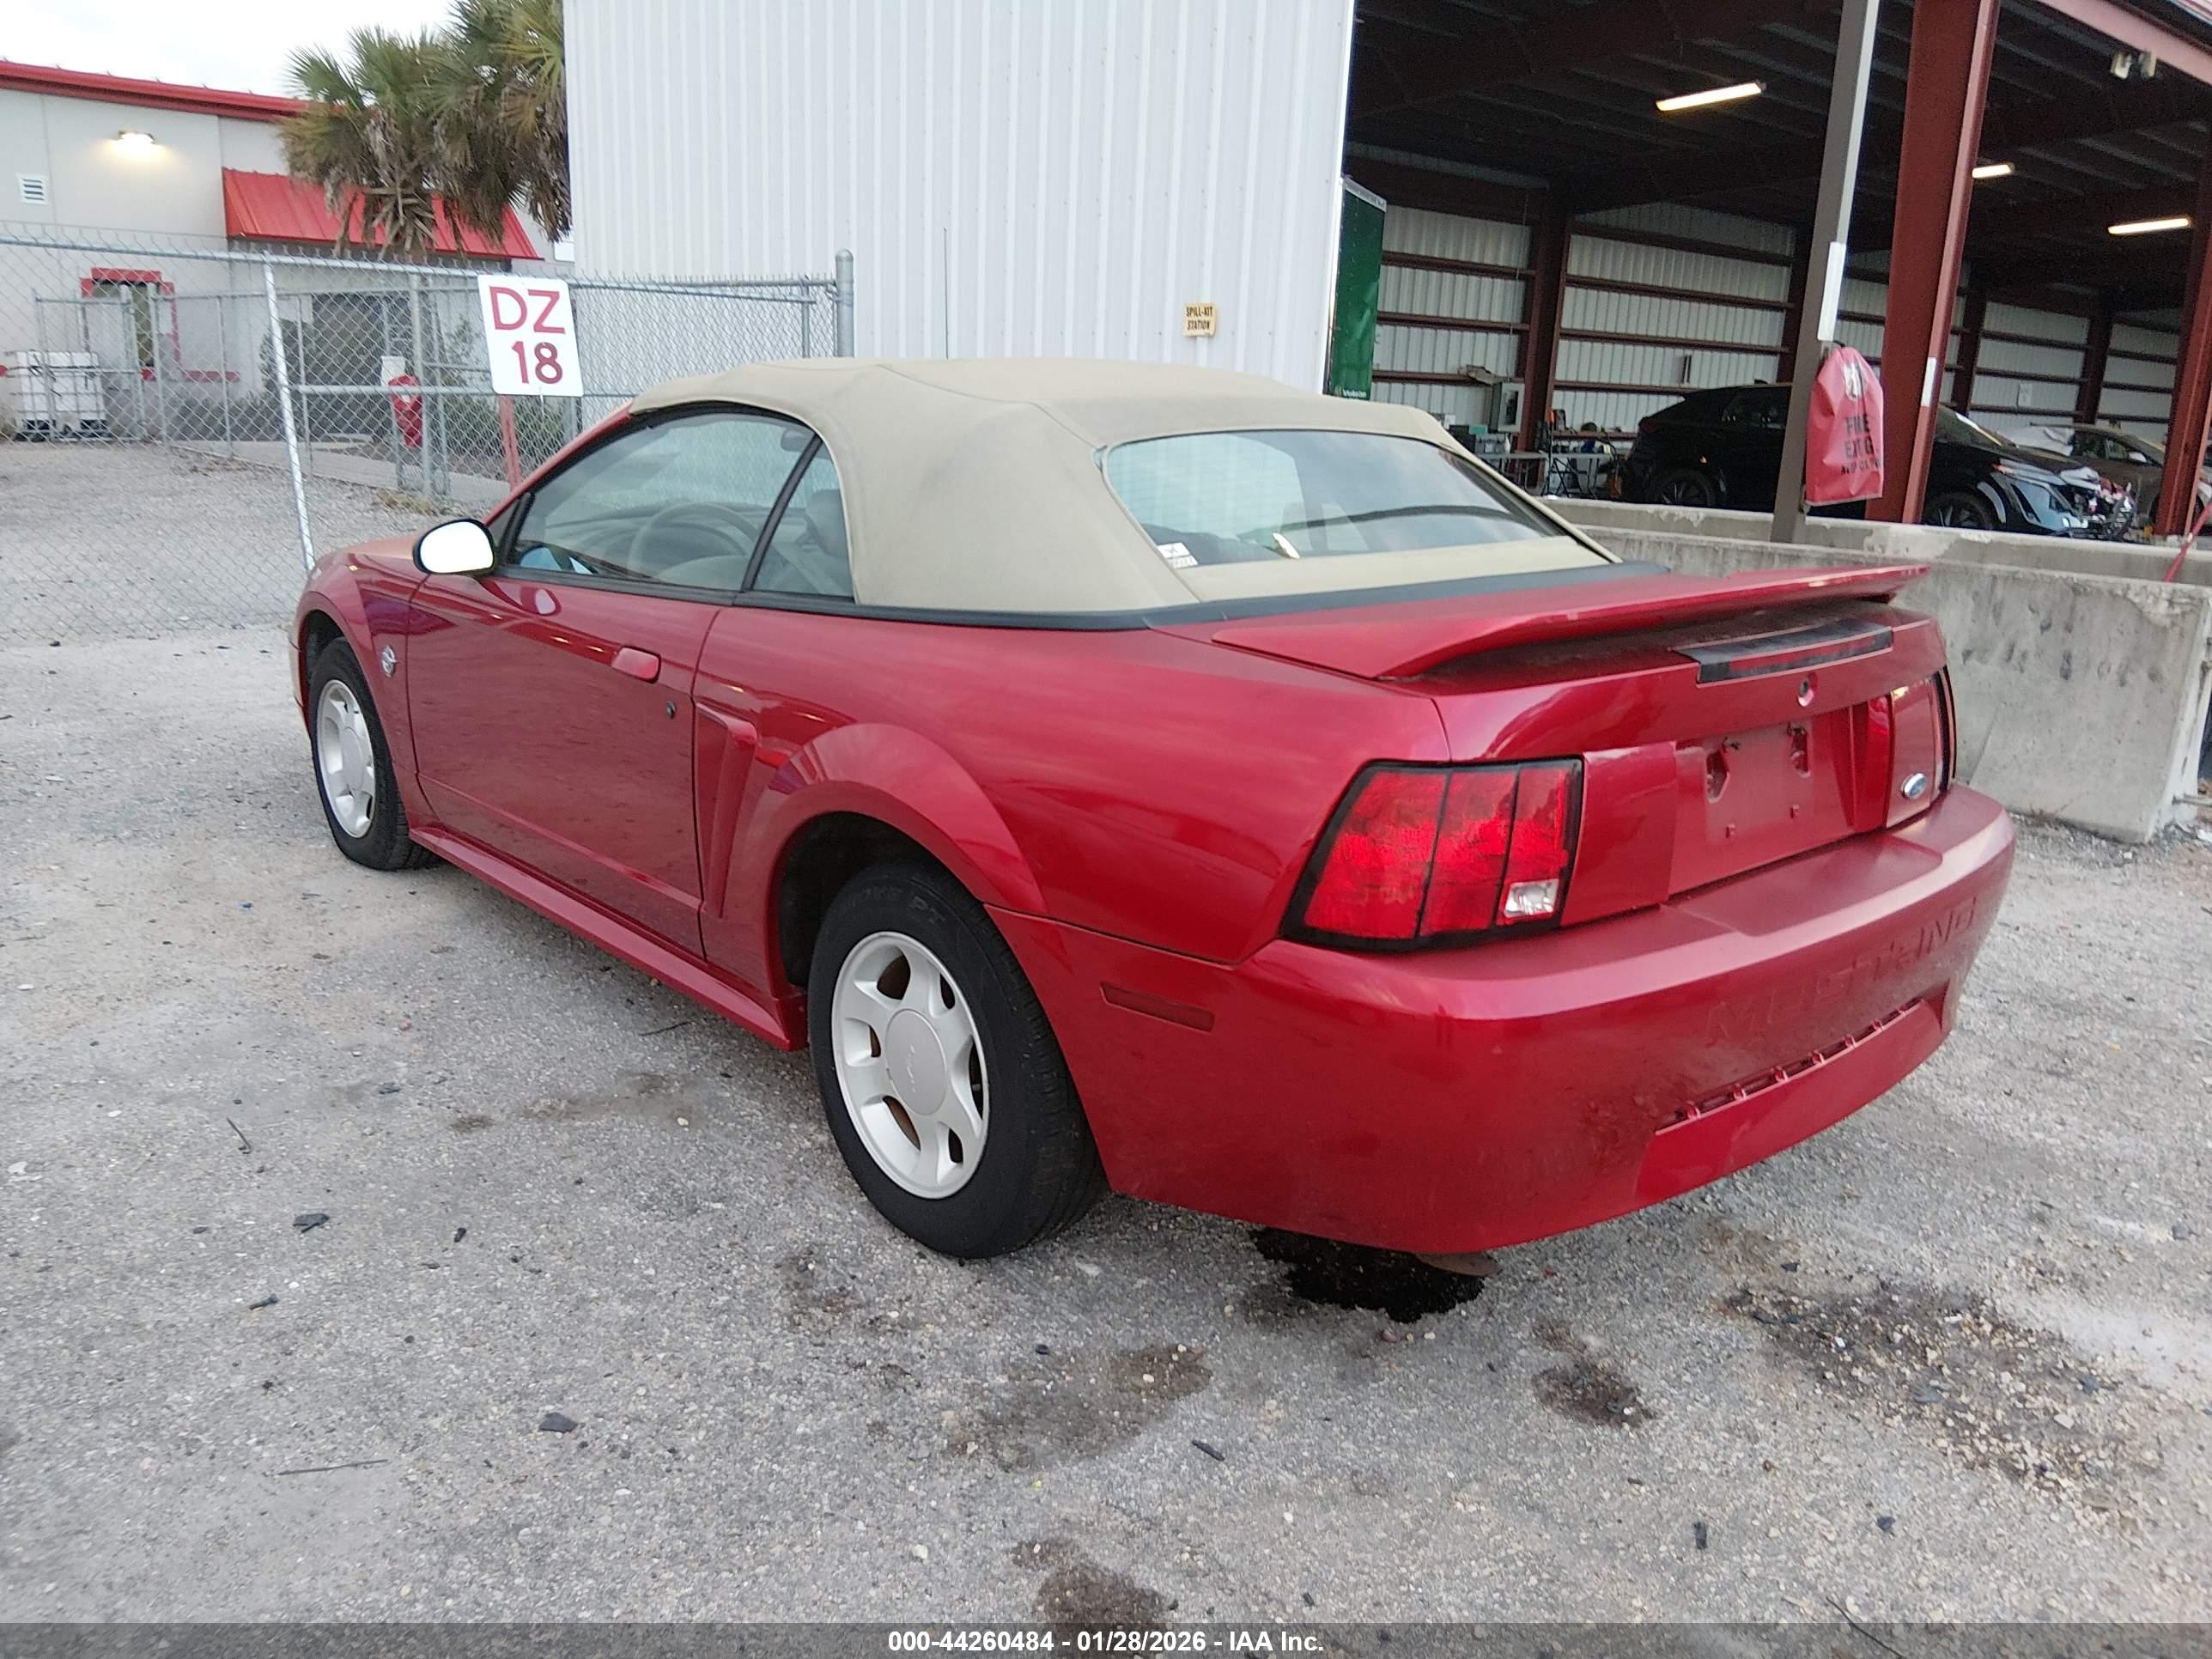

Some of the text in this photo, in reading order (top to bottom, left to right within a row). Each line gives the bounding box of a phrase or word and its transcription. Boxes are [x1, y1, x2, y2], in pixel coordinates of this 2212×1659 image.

[489, 285, 566, 334] DZ
[1187, 319, 1210, 330] STATION
[511, 341, 562, 384] 18
